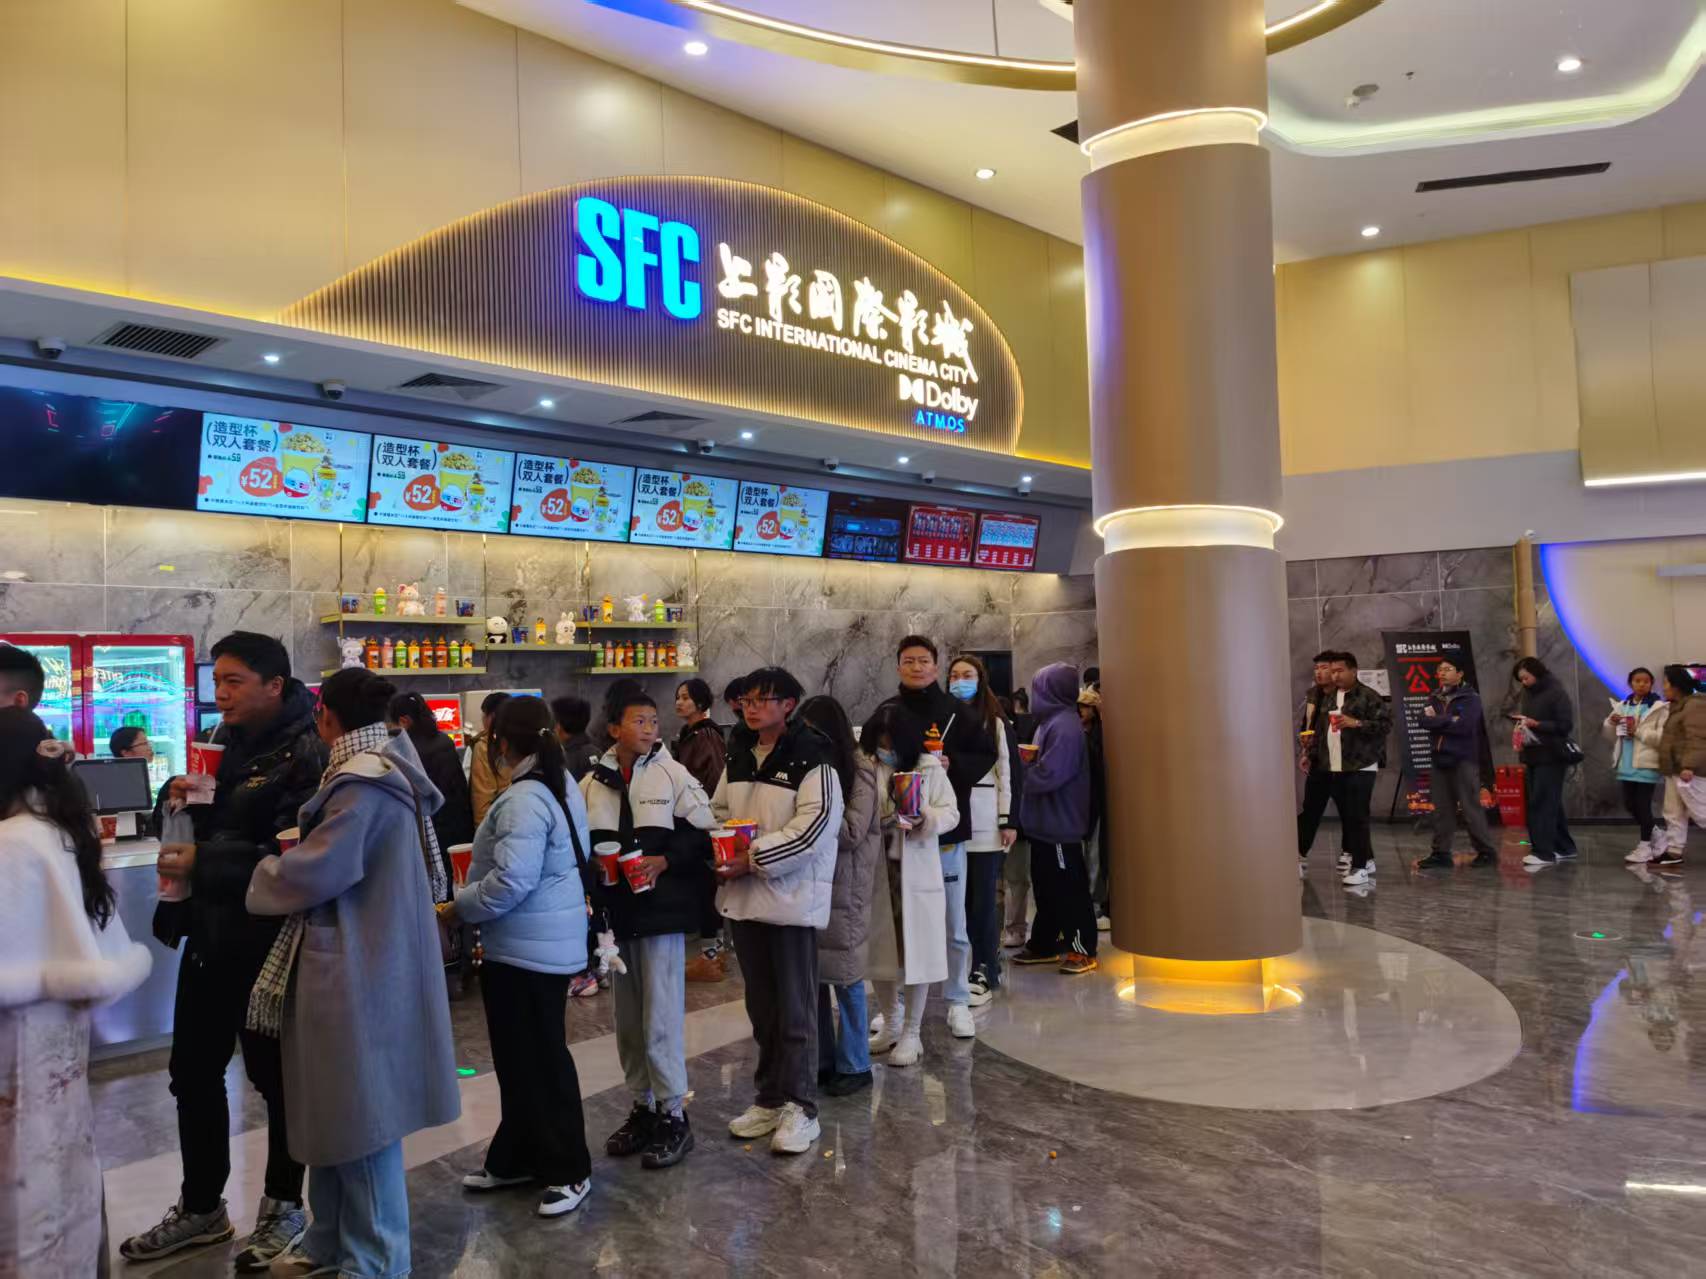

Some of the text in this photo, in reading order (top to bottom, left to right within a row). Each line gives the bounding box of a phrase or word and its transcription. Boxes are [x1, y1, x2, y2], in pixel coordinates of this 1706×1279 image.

[575, 197, 701, 320] SFC
[717, 308, 970, 385] SFC INTERNATIONAL CINEMA CITY
[926, 380, 979, 421] Dolby
[213, 421, 258, 437] 造型杯
[915, 409, 966, 433] ATMOS
[212, 435, 271, 453] 双人套餐
[383, 442, 420, 457] 造型杯
[382, 455, 432, 470] 双人套餐
